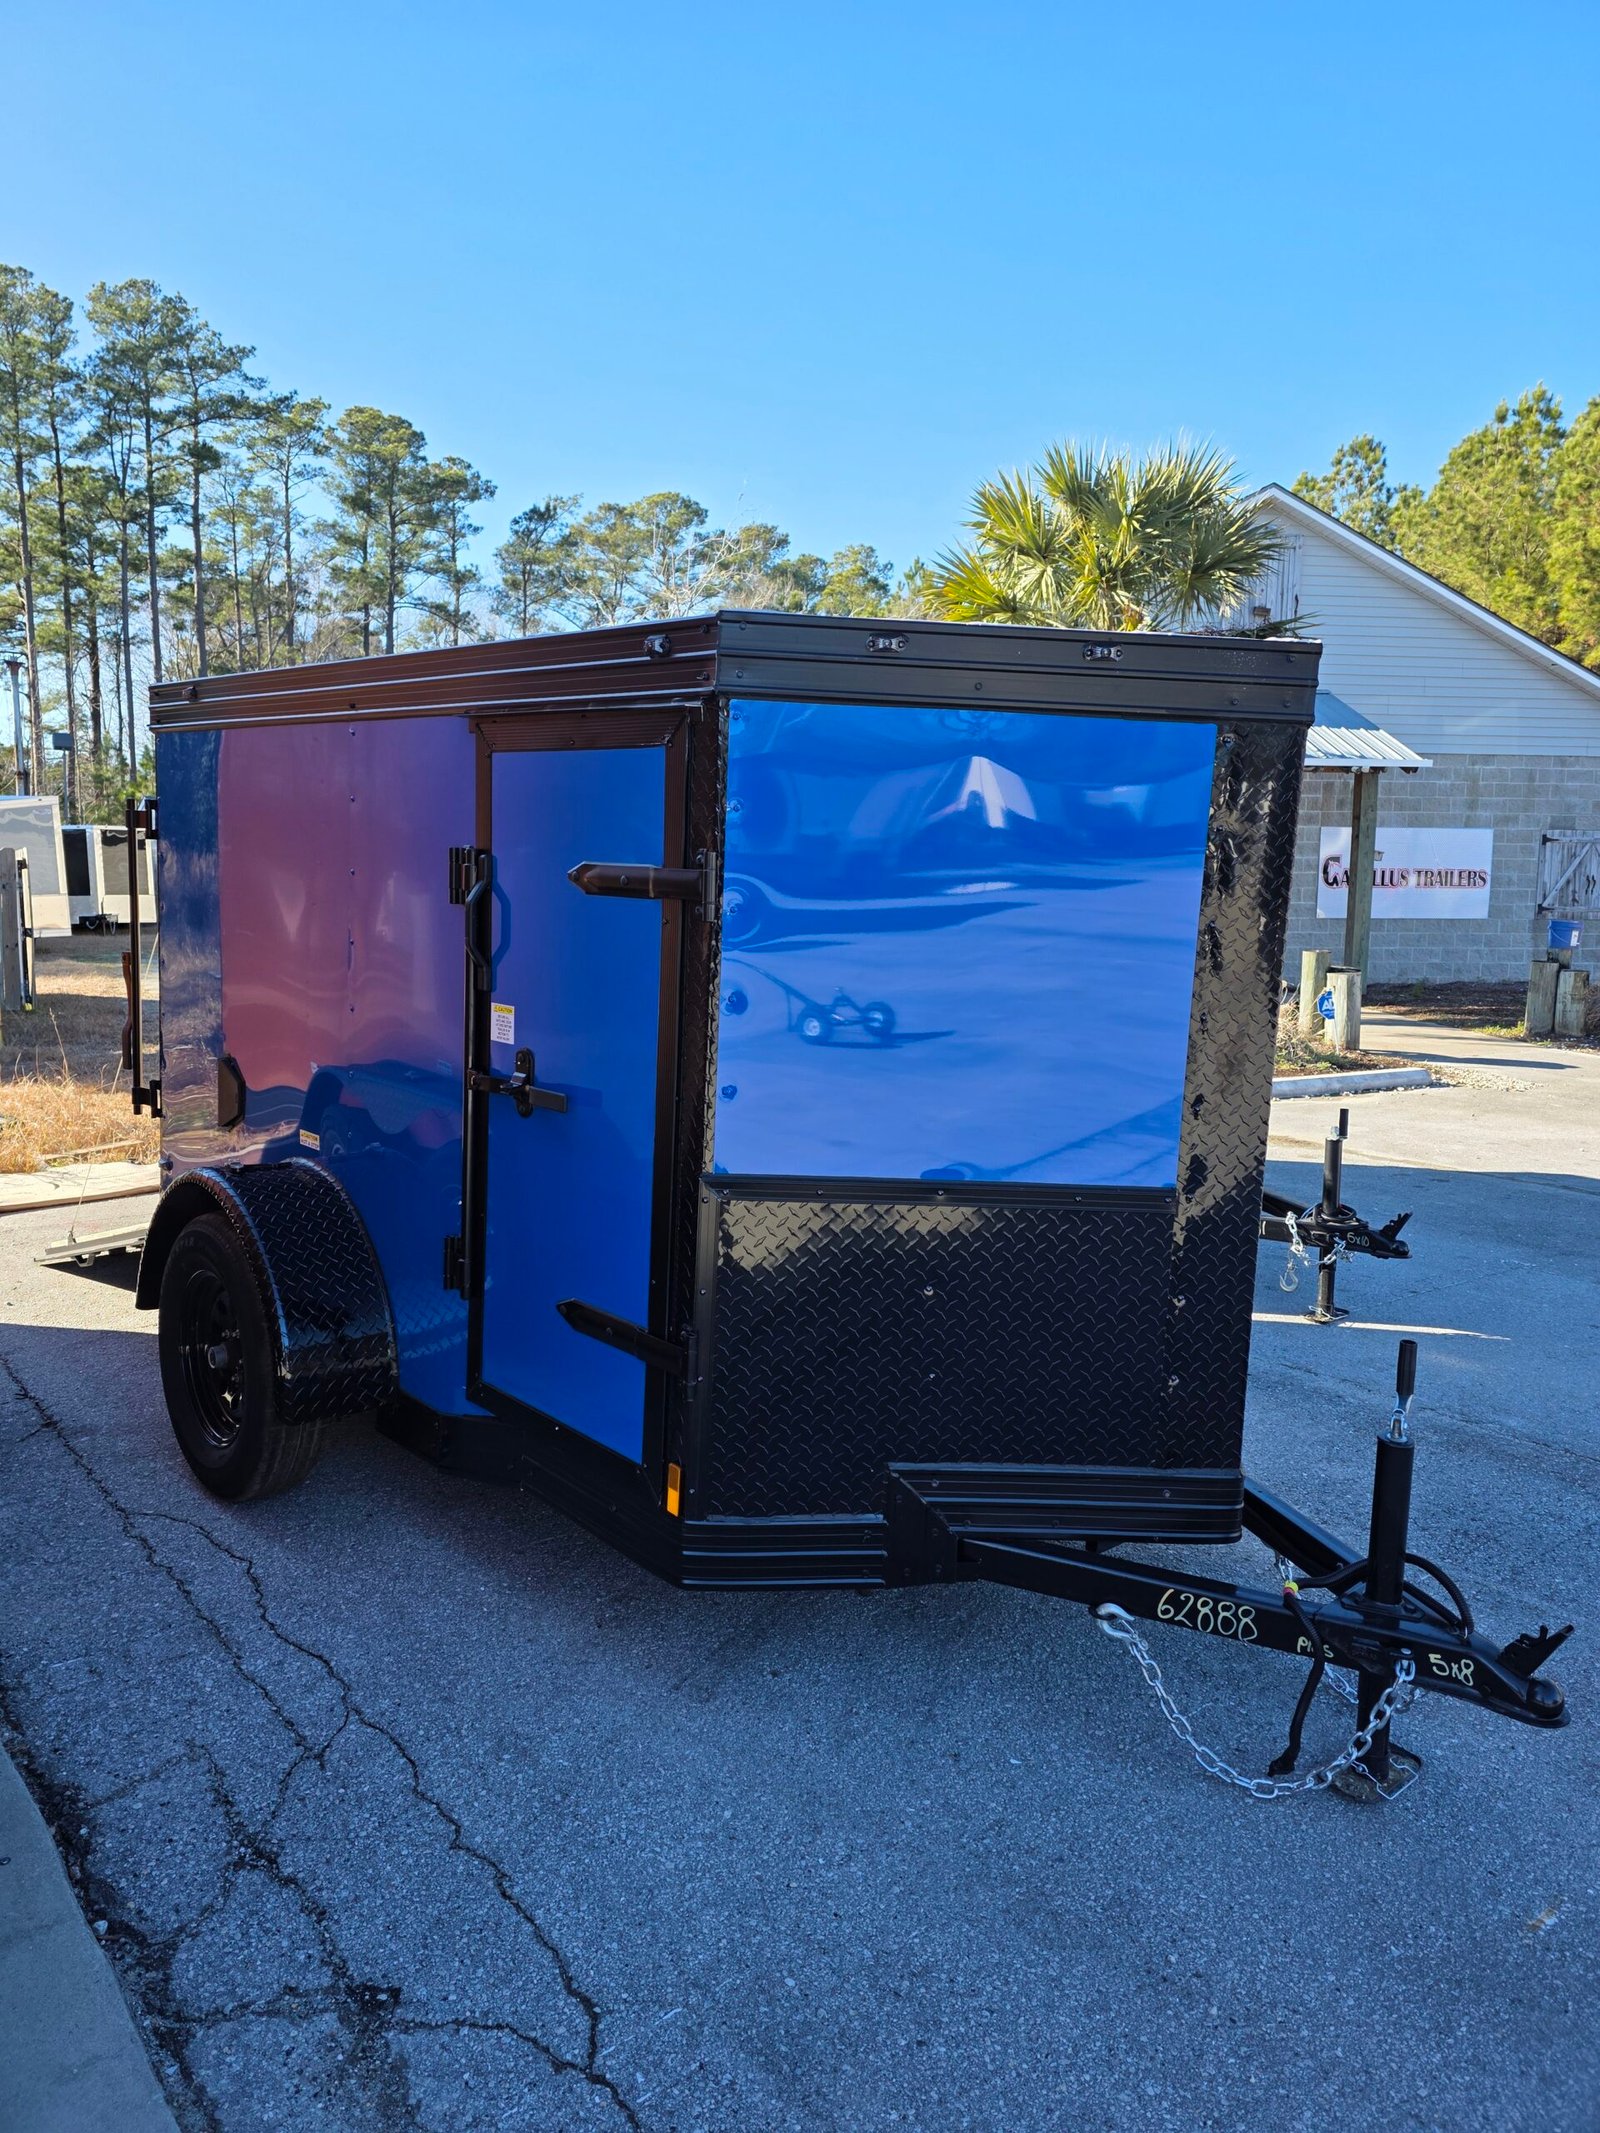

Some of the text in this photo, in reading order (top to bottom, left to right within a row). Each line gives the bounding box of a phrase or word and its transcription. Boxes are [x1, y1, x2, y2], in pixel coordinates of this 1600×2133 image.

[1322, 855, 1489, 888] CALLUS TRAILERS
[1346, 1231, 1370, 1247] 6x10
[1157, 1588, 1258, 1646] 62888
[1428, 1653, 1474, 1686] 5x8
